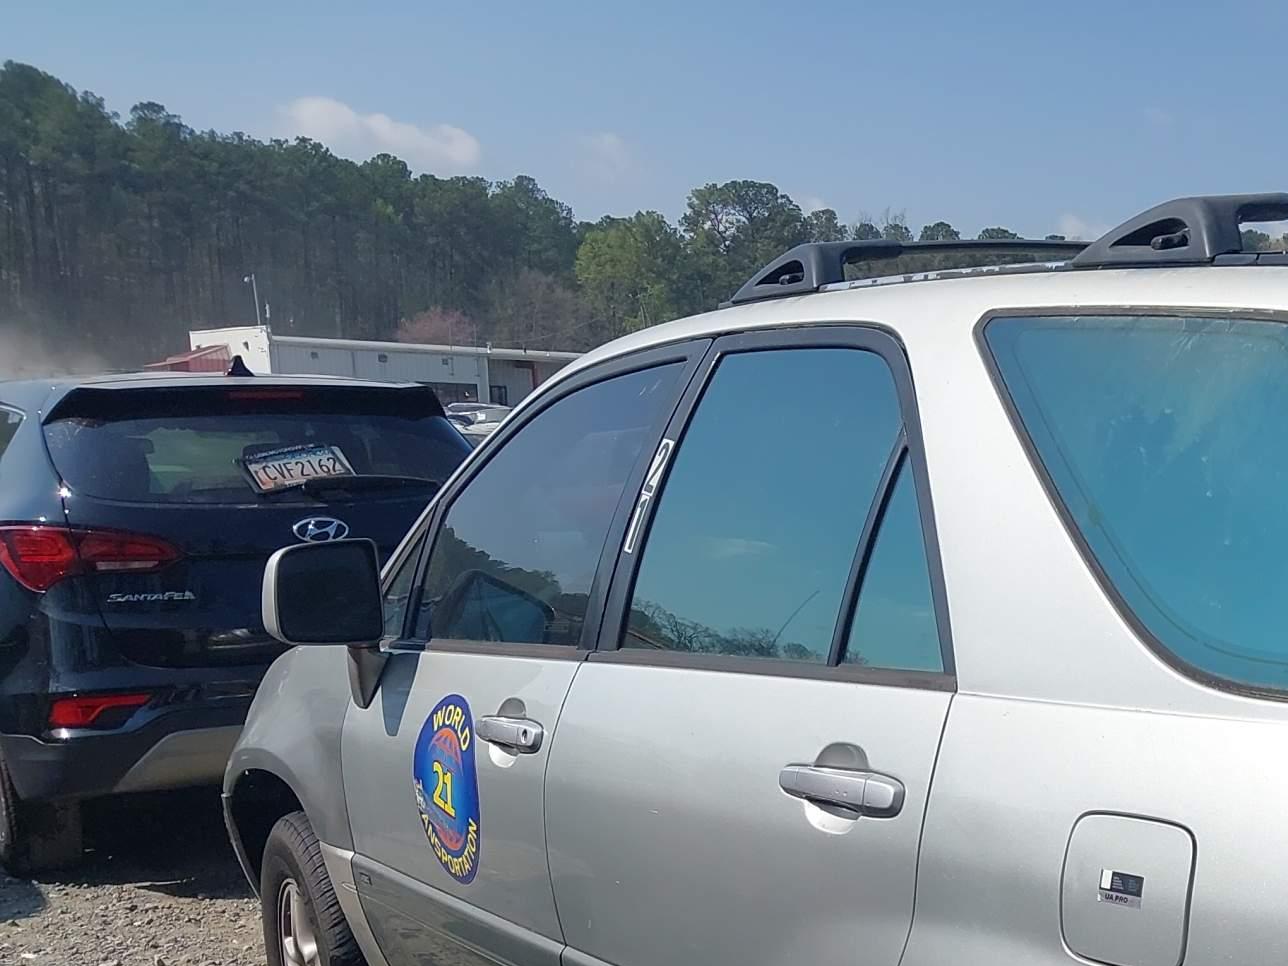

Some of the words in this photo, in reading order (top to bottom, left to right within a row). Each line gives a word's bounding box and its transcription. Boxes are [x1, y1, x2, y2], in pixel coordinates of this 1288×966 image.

[262, 457, 337, 481] CVF2162
[433, 704, 471, 752] WORLD
[433, 761, 455, 818] 21
